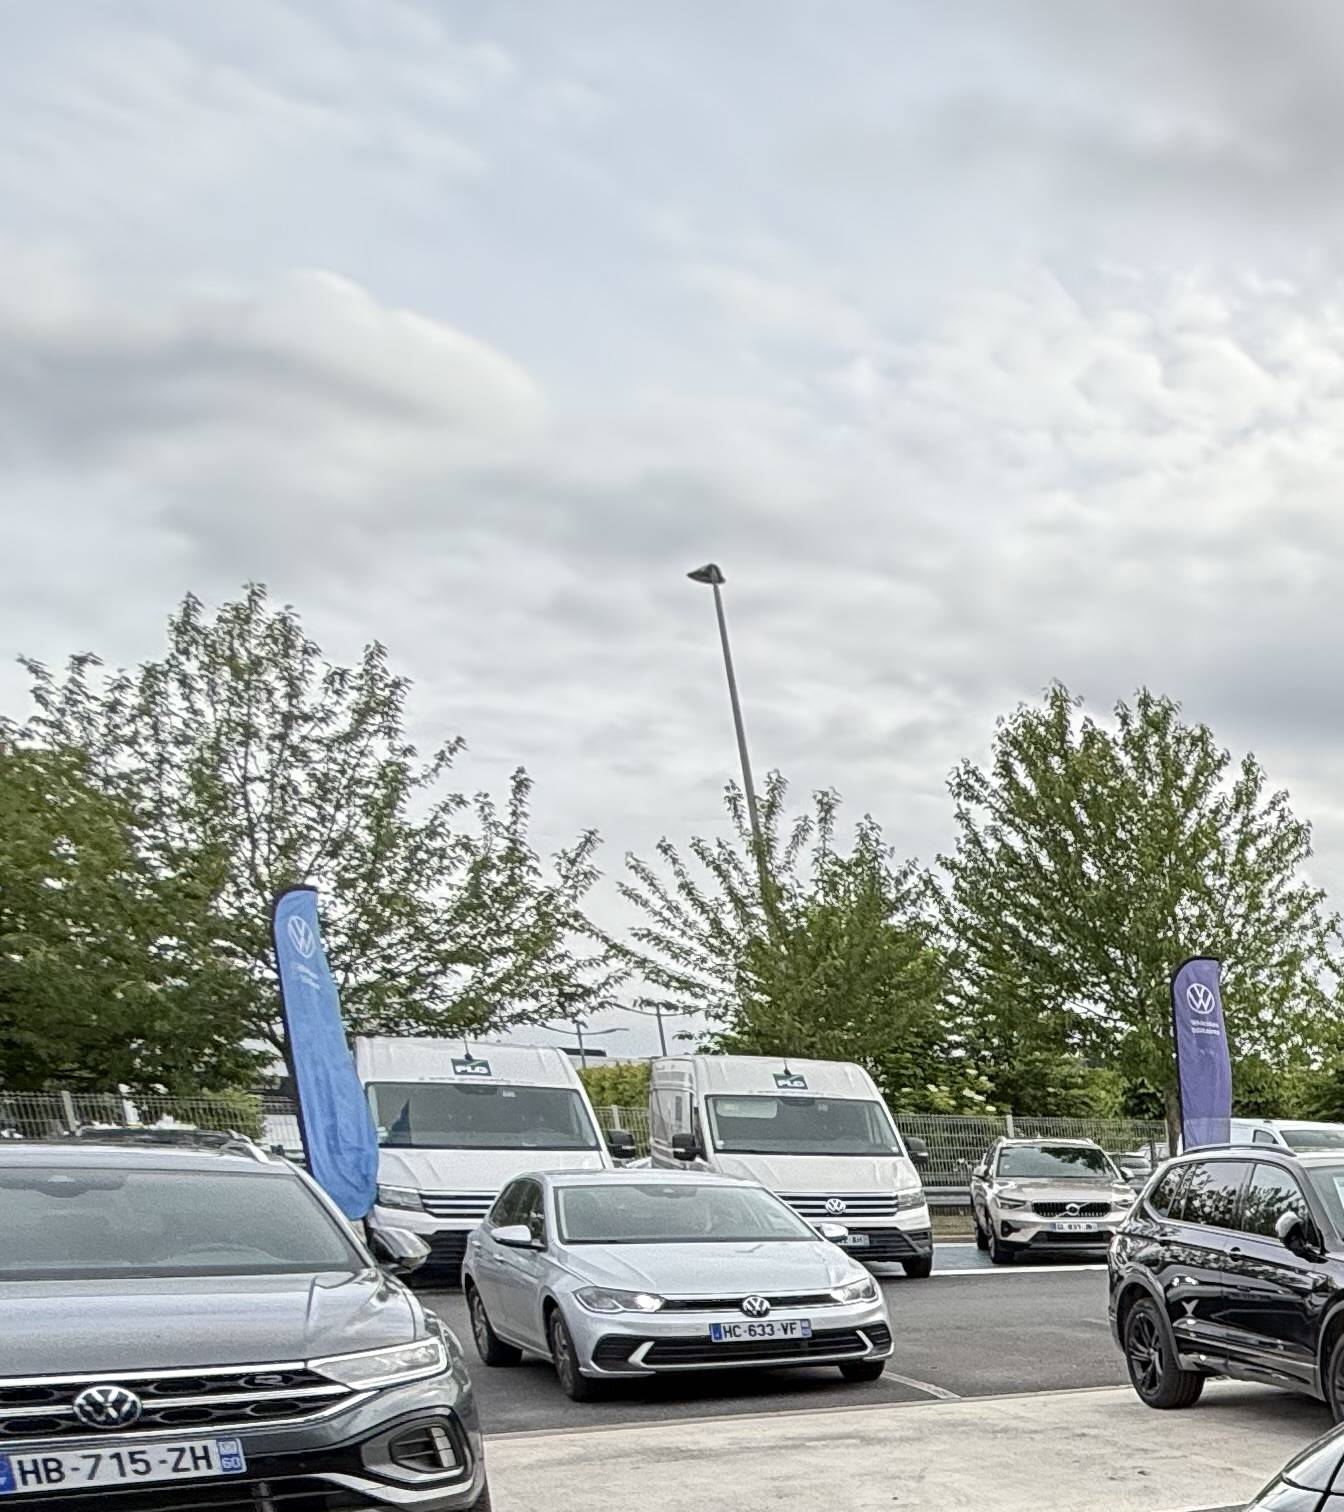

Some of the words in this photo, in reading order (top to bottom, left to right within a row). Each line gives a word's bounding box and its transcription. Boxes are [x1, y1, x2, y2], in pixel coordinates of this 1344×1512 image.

[1187, 983, 1215, 1014] VW
[723, 1322, 797, 1338] HC-633-VF
[17, 1445, 214, 1487] HB-715-ZH
